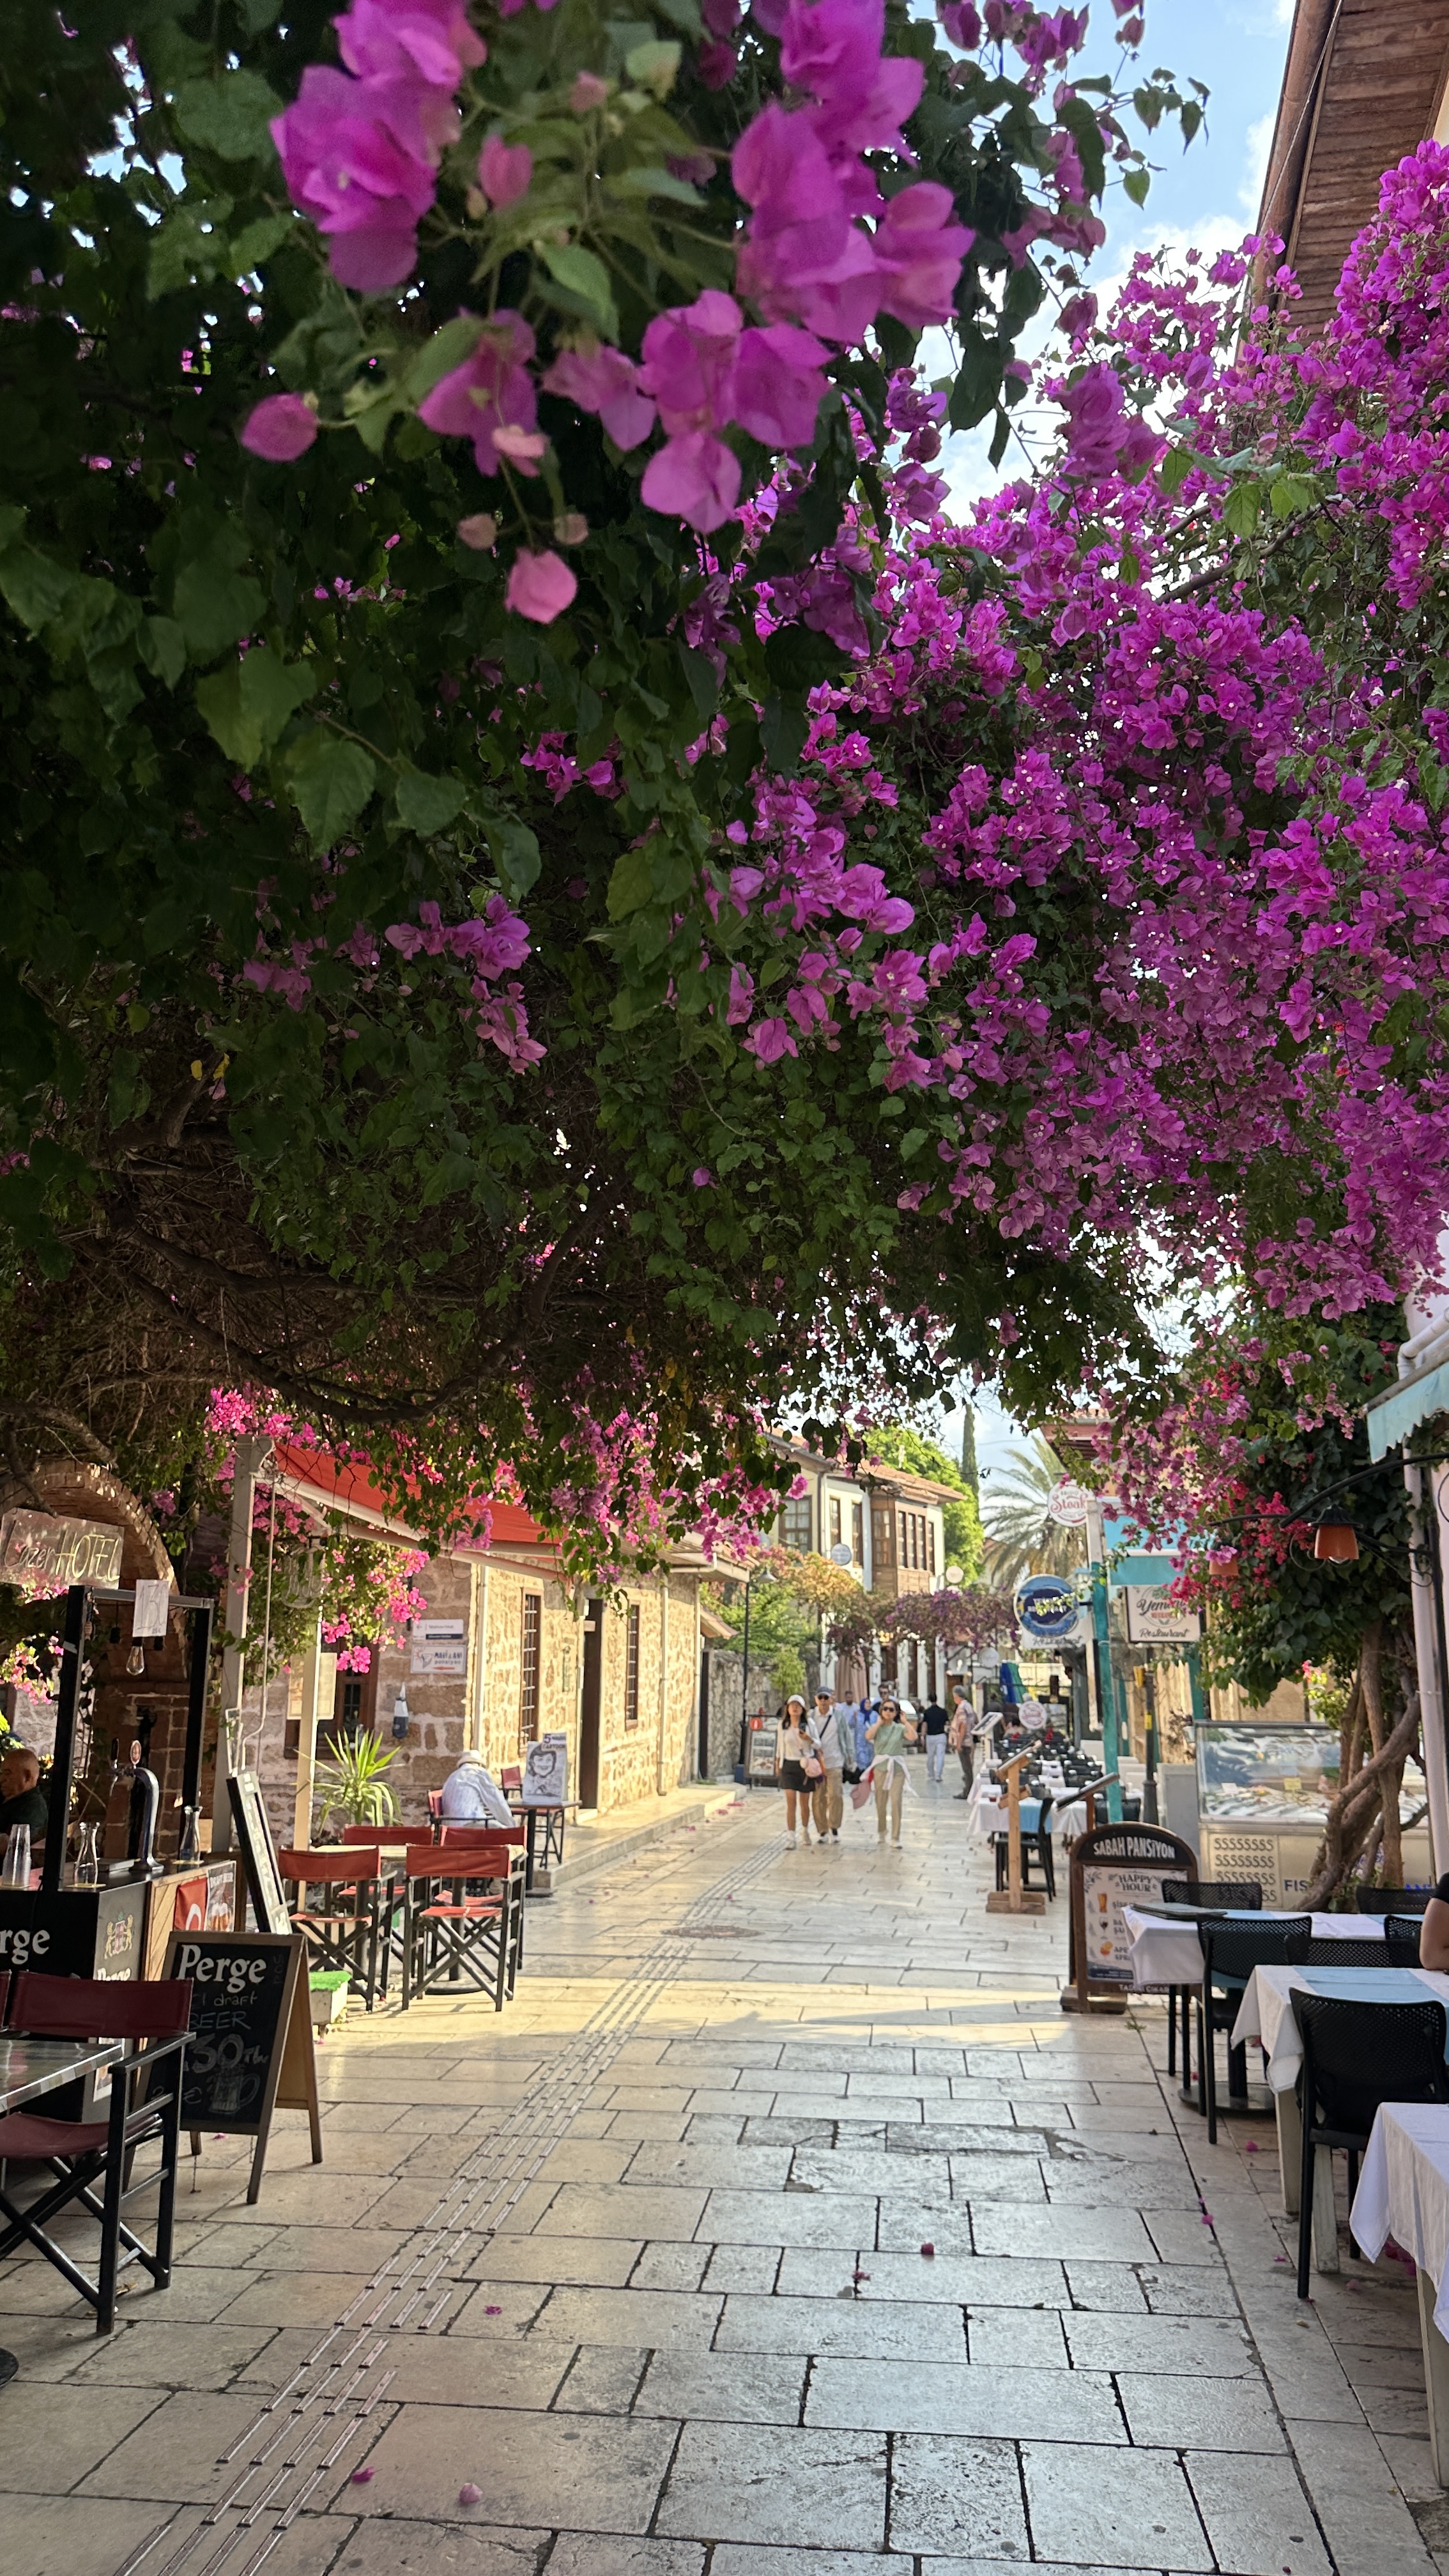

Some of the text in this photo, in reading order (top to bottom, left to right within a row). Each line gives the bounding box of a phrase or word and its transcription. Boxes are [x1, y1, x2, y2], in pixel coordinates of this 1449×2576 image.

[55, 1529, 120, 1582] HOTEL
[1139, 1628, 1190, 1637] Restaurant
[1093, 1836, 1126, 1857] SABAH
[1119, 1874, 1152, 1883] HAPPY
[1284, 1879, 1308, 1891] FIS
[1122, 1883, 1151, 1892] HOUR
[176, 1944, 267, 1993] Perge
[213, 1990, 258, 2007] draft
[190, 2011, 252, 2030] BEER
